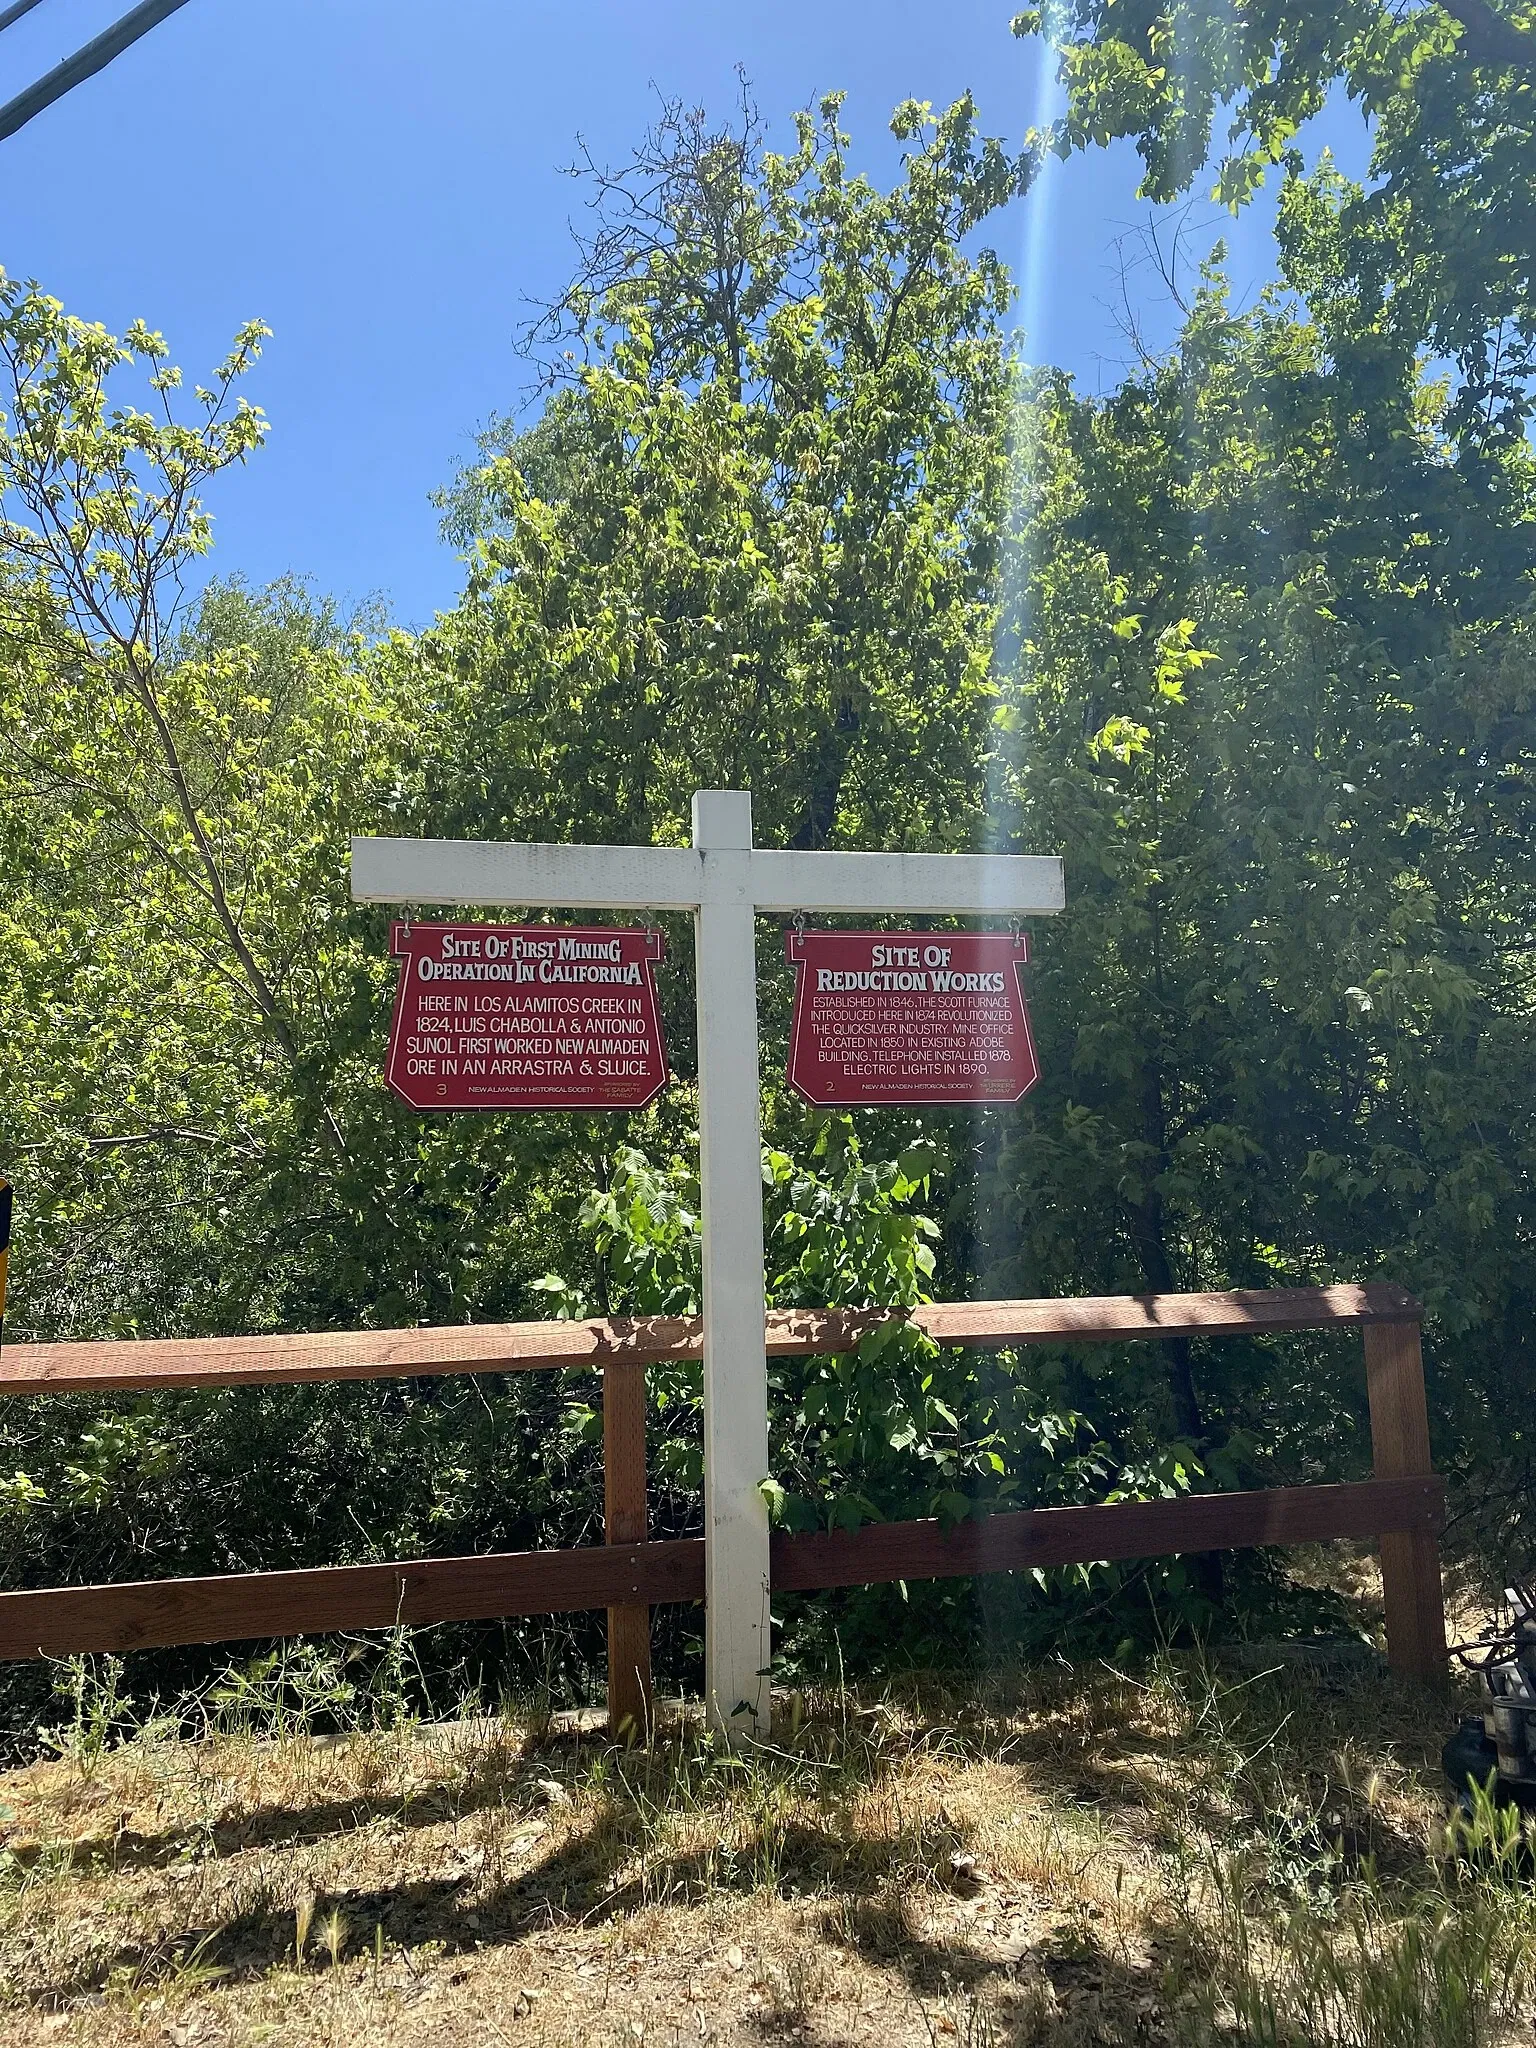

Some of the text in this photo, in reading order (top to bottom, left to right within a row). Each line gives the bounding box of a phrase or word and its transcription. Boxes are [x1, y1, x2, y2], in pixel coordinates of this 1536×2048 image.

[442, 933, 621, 962] SITE OF FIRST MINING
[872, 944, 951, 967] SITE OF
[418, 956, 643, 985] OPERATION IN CALIFORNIA
[816, 969, 1004, 992] REDUCTION WORKS
[419, 996, 642, 1014] HERE IN LOS ALAMITOS CREEK IN
[813, 997, 1010, 1008] ESTABLISHED IN 1846. THE SCOTT FURNACE
[811, 1010, 1012, 1021] INTRODUCED HERE IN 1874 REVOLUTIONIZED
[416, 1017, 646, 1034] 1824, LUIS CHABOLLA & ANTONIO
[812, 1024, 1014, 1035] THE QUICKSILVER INDUSTRY. MINE OFFICE
[407, 1038, 649, 1055] SUNOL FIRST WORKED NEW ALMADEN
[820, 1037, 1004, 1048] LOCATED IN 1850 IN EXISTING ADOBE
[819, 1051, 1013, 1062] BUILDING. TELEPHONE INSTALLED 1878.
[407, 1059, 650, 1076] ORE IN AN ARRASTRA & SLUICE.
[844, 1064, 989, 1075] ELECTRIC LIGHTS IN 1890.
[436, 1084, 447, 1095] 3
[826, 1082, 835, 1091] 2
